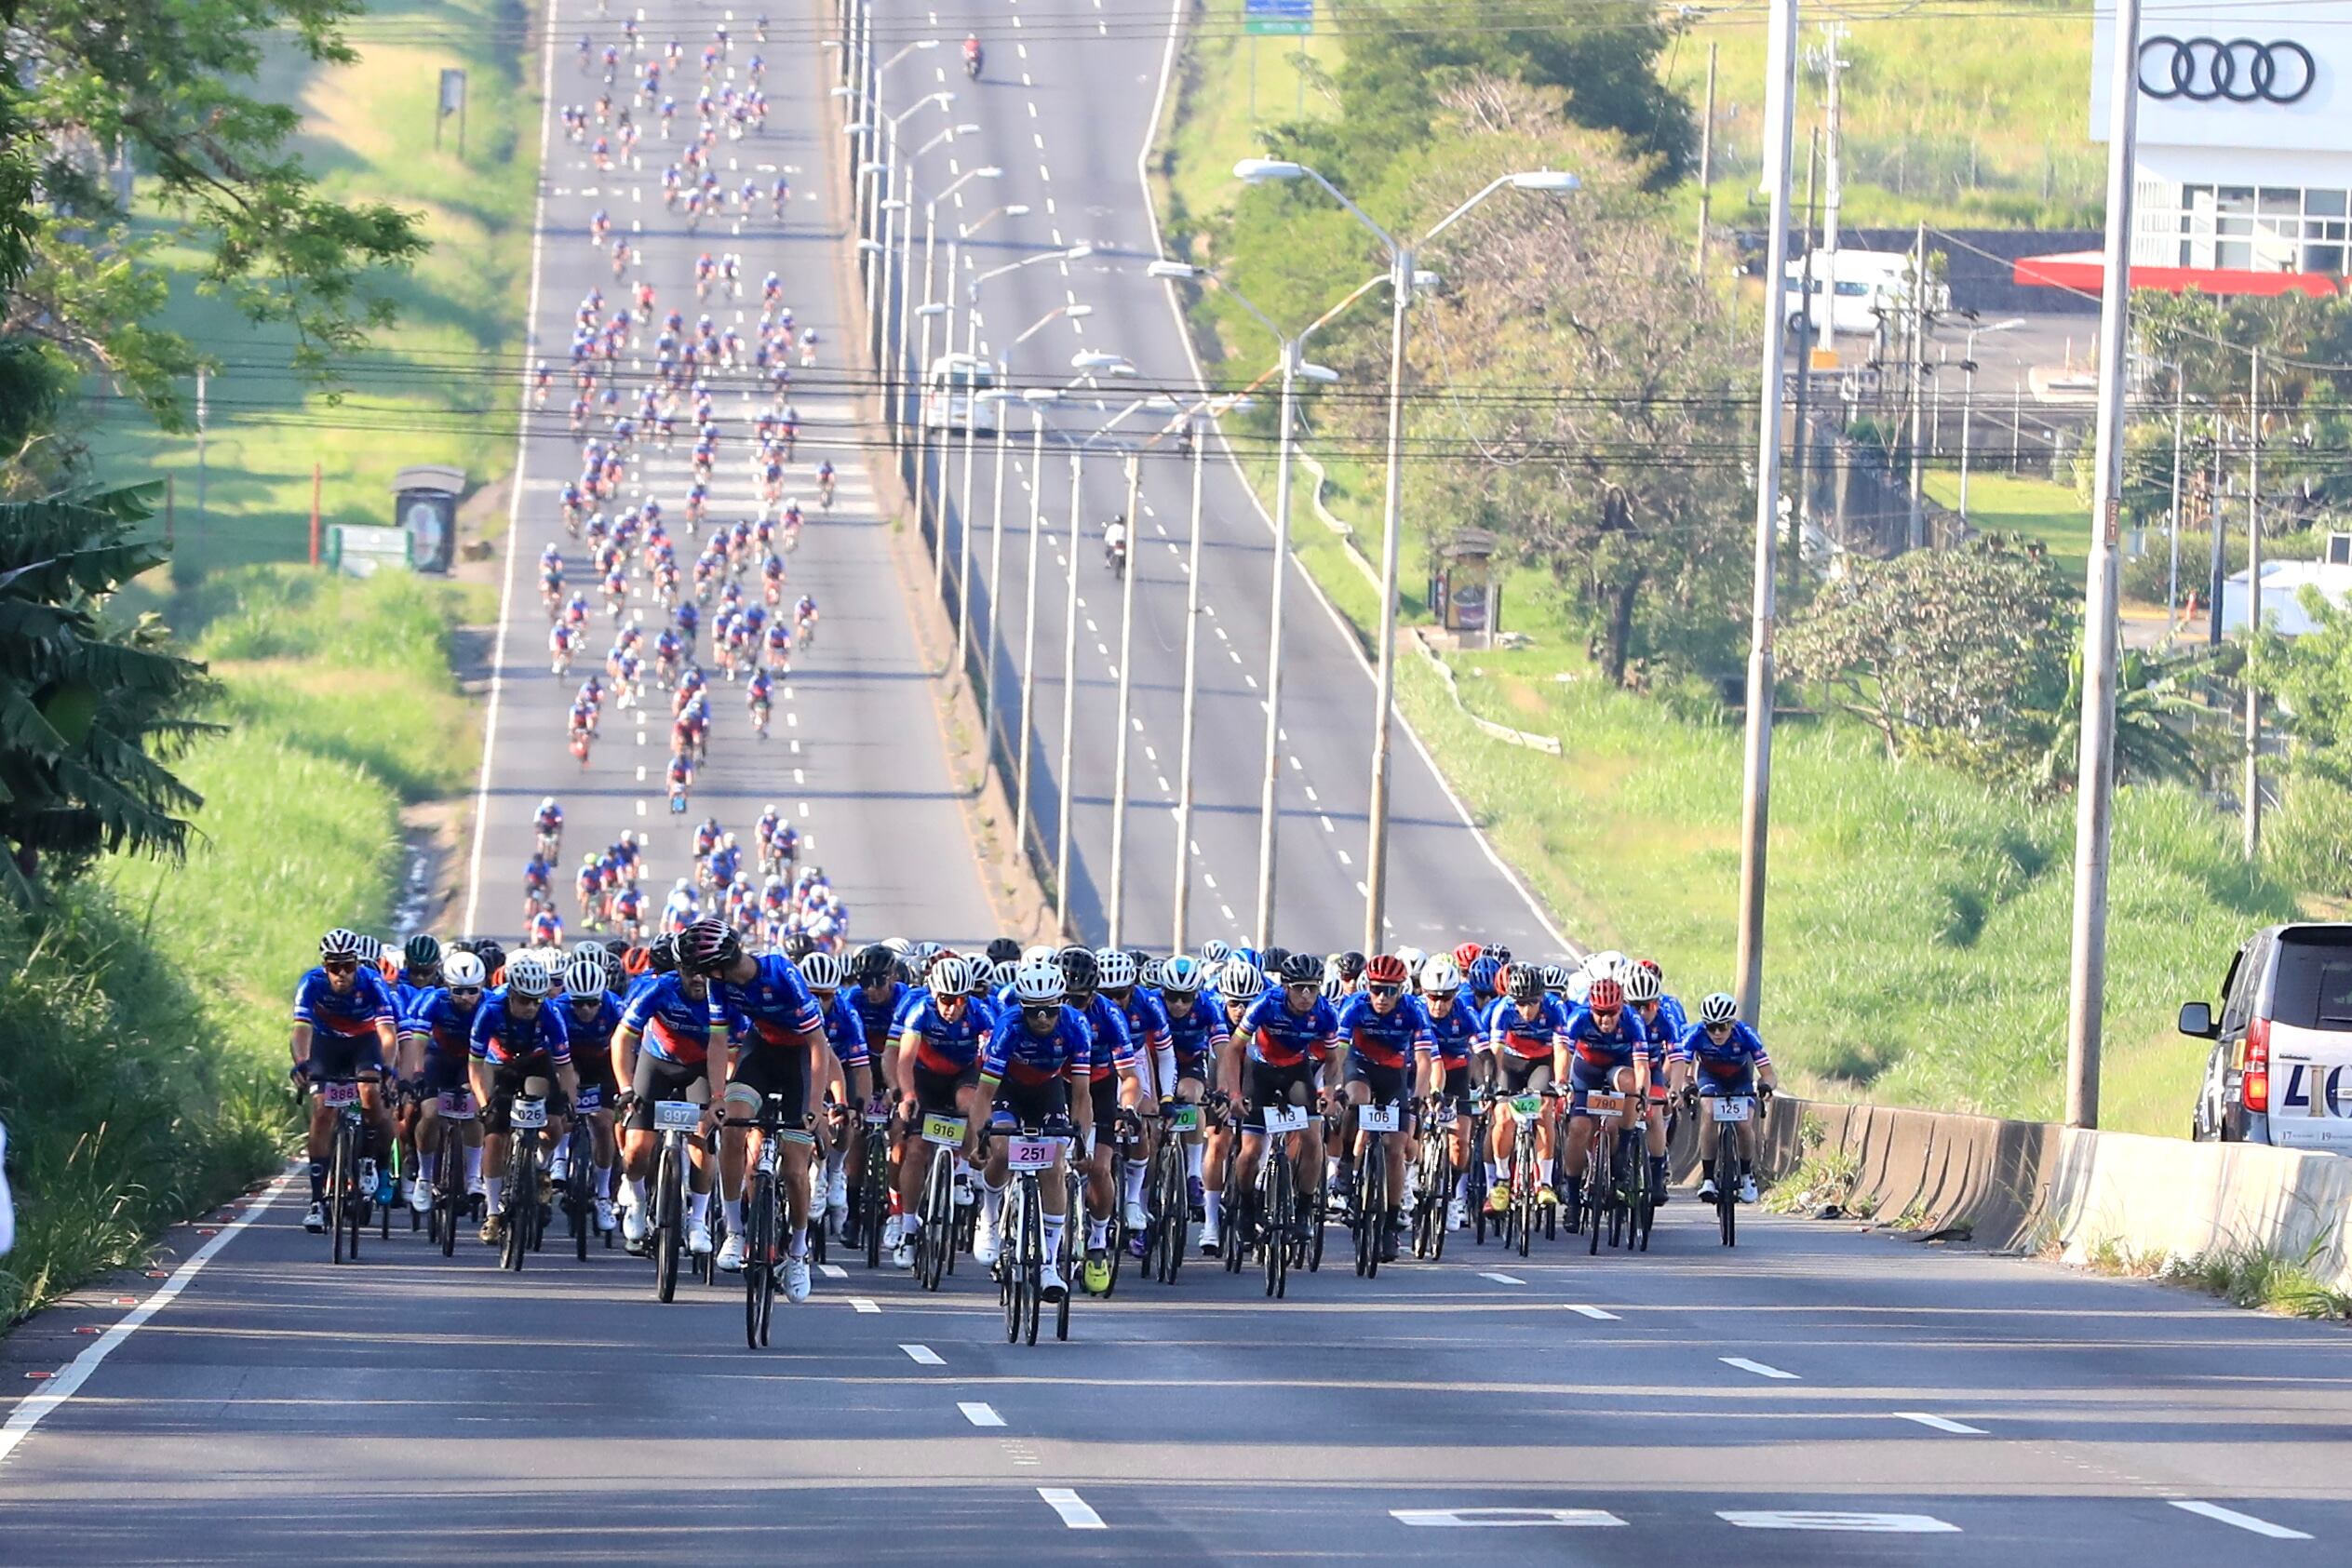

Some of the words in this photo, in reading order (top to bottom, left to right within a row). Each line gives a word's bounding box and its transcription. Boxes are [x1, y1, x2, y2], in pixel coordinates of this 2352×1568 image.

[330, 1088, 354, 1101] 386
[445, 1100, 467, 1112] 33
[1721, 1105, 1740, 1114] 125
[518, 1109, 541, 1120] 026
[664, 1110, 690, 1122] 997
[1275, 1112, 1296, 1123] 113
[1368, 1112, 1390, 1123] 106
[934, 1123, 955, 1137] 916
[1020, 1147, 1045, 1160] 251
